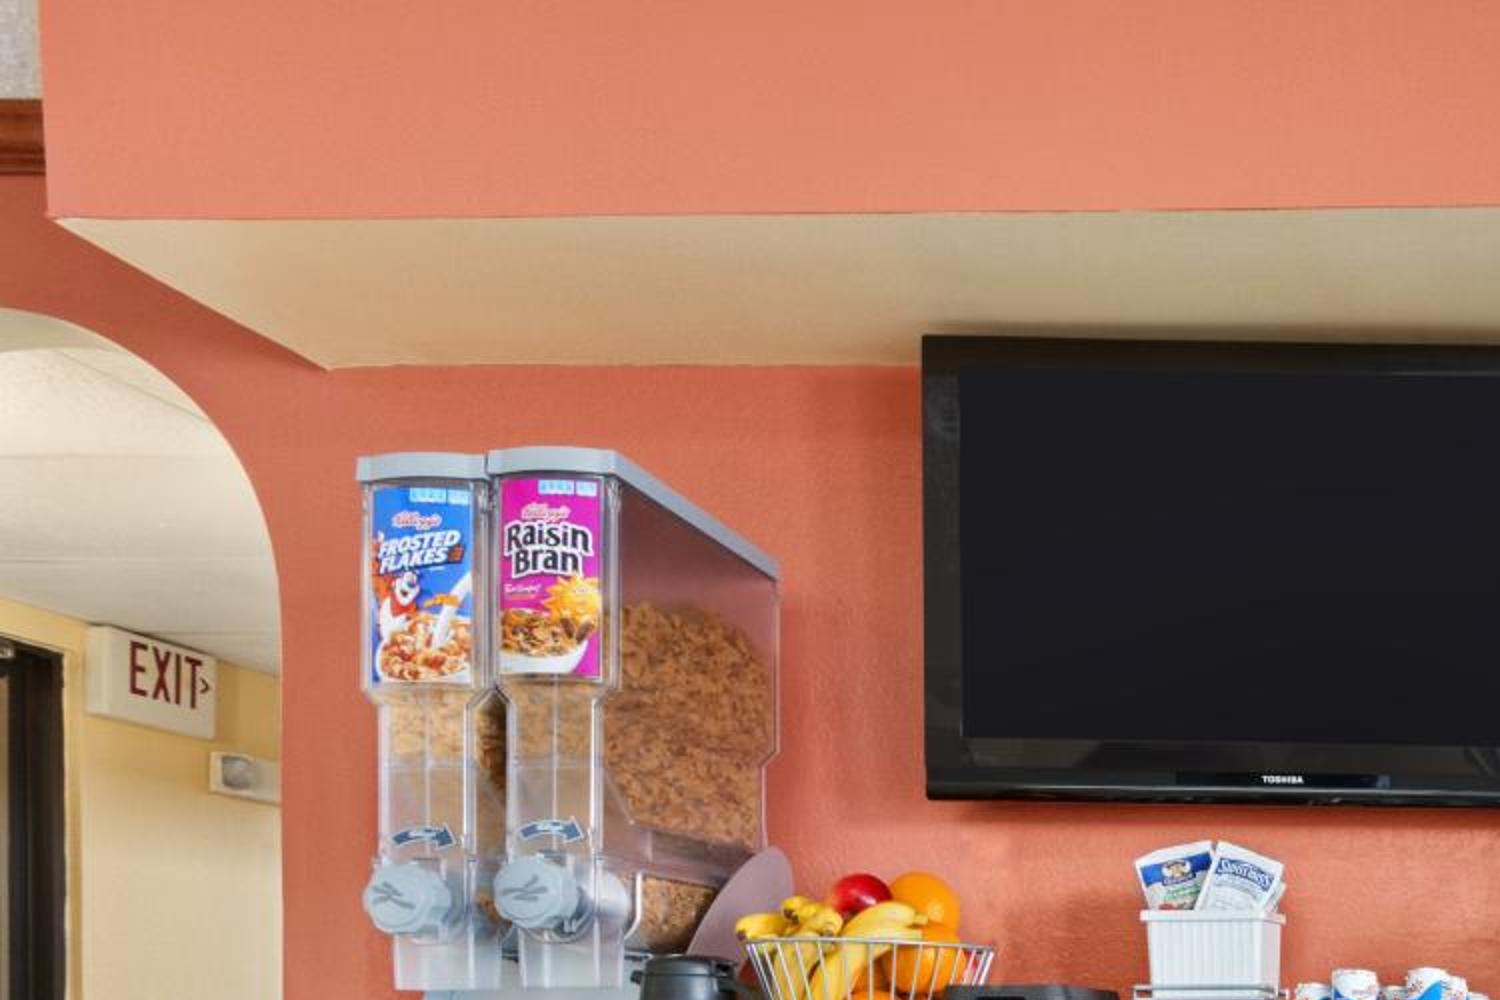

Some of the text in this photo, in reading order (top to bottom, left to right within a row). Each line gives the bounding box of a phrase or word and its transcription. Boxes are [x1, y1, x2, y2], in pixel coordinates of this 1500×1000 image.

[379, 530, 461, 560] FROSTED
[505, 521, 591, 554] Raisin
[379, 547, 449, 575] FLAKES
[514, 548, 580, 576] Bran
[129, 640, 202, 709] EXIT
[1261, 775, 1304, 785] TOSHIBA
